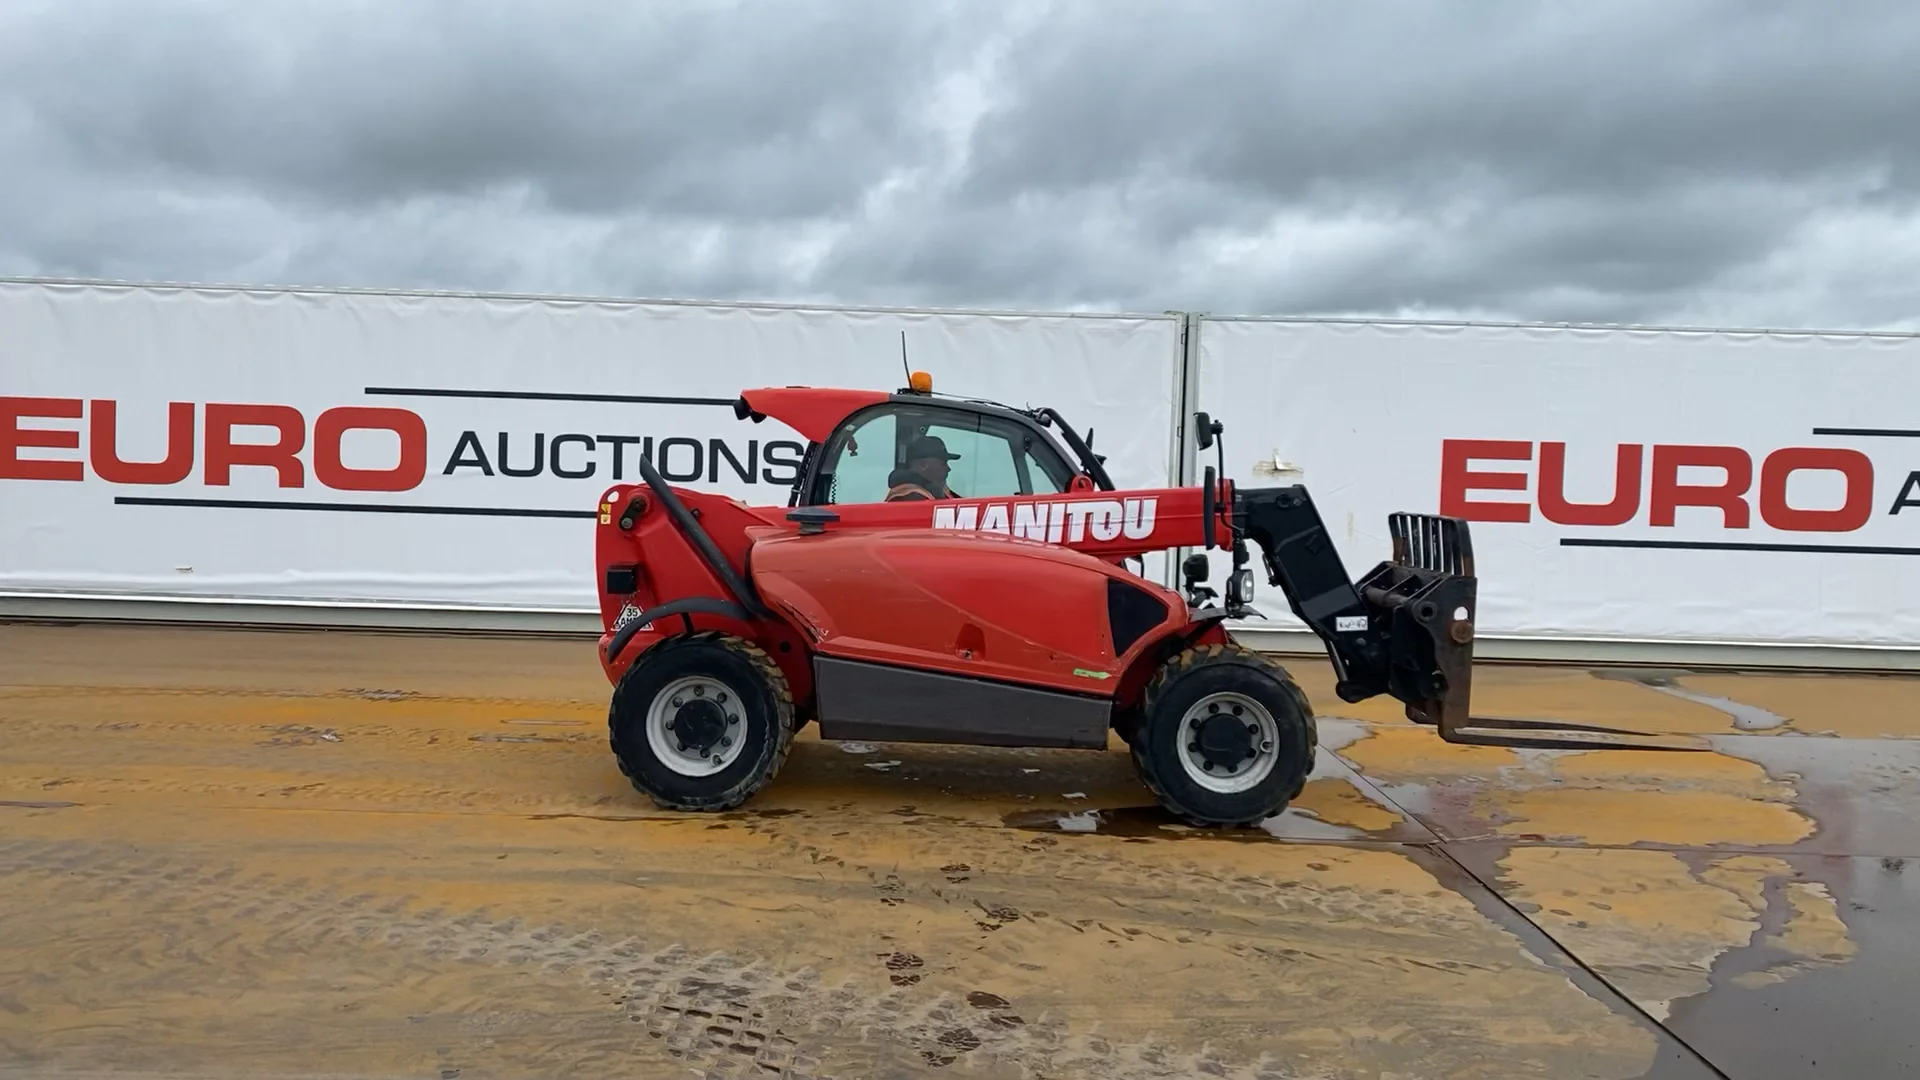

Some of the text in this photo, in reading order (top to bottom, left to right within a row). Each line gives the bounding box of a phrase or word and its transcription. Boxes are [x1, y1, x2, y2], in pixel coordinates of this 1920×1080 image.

[0, 396, 804, 492] EURO AUCTIONS
[932, 497, 1159, 544] MANITOU
[1439, 439, 1874, 532] EURO
[626, 608, 638, 617] 35
